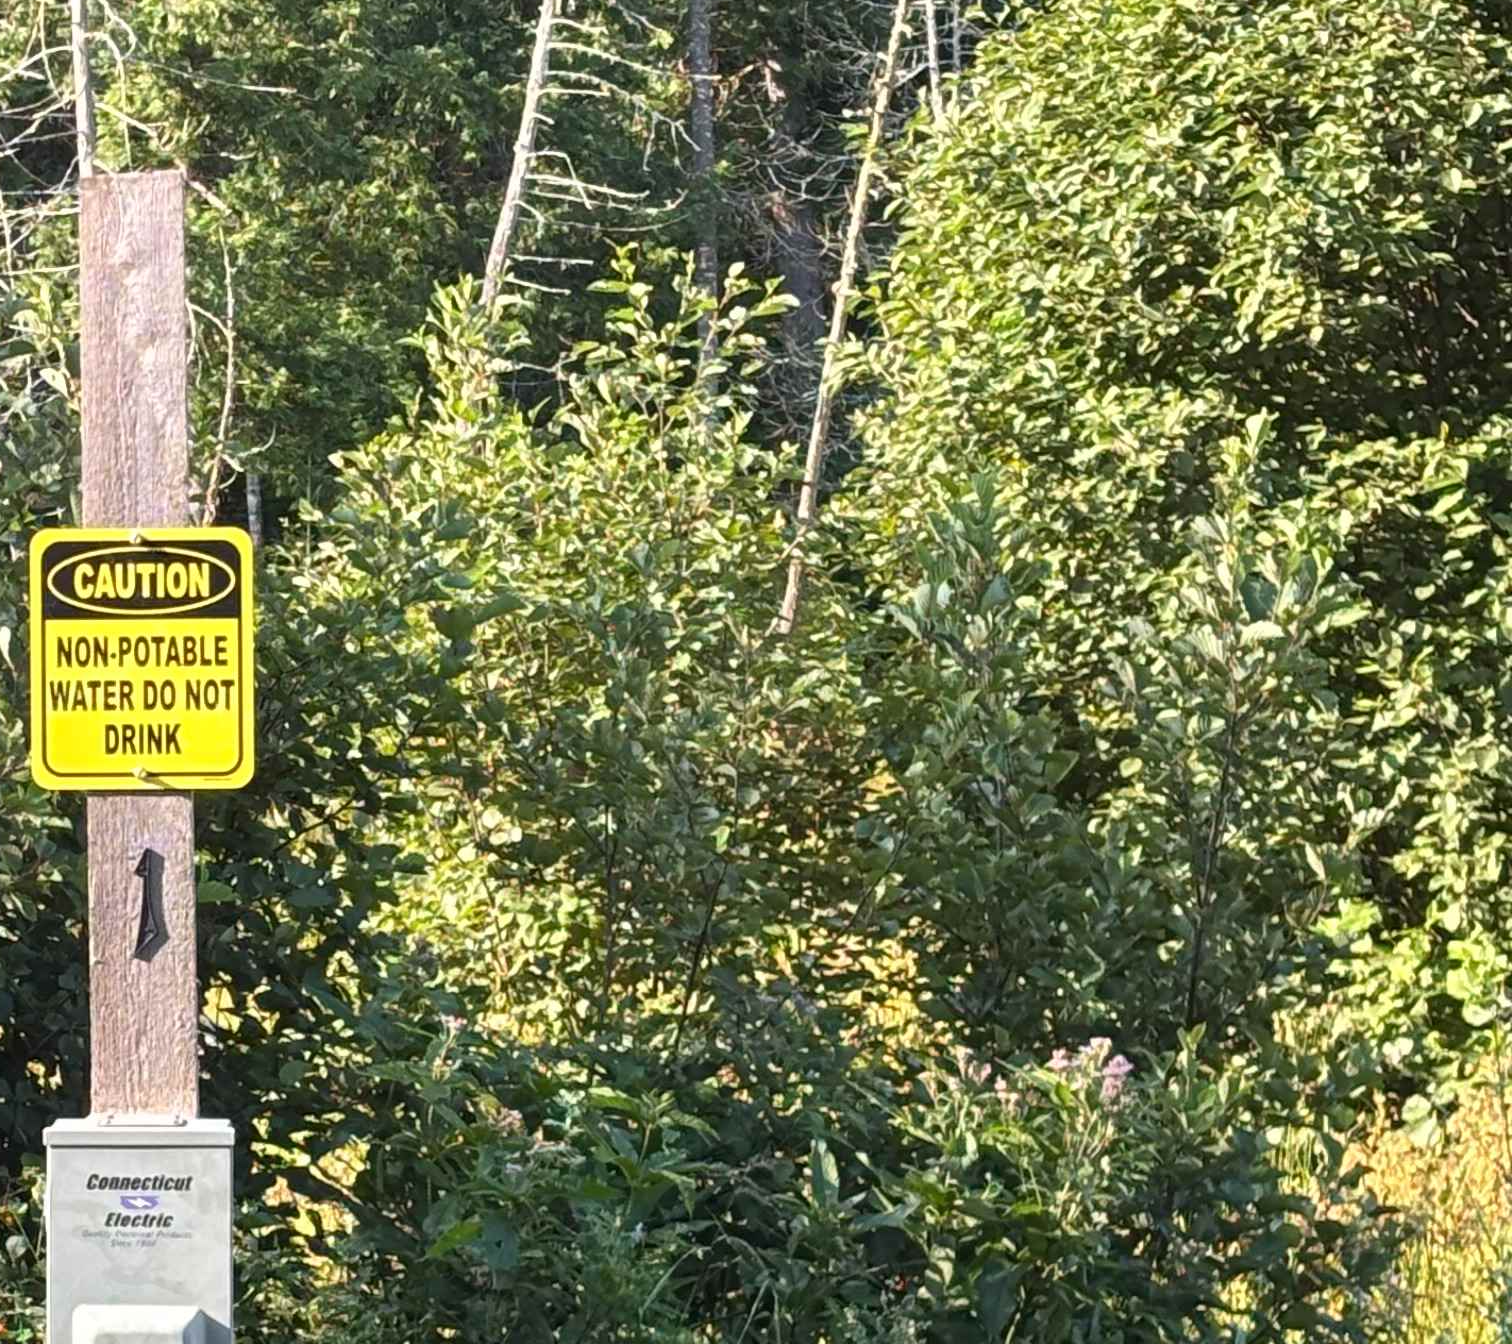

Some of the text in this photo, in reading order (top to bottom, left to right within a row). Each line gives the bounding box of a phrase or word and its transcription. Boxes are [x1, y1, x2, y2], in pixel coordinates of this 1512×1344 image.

[73, 562, 210, 599] CAUTION
[56, 635, 228, 667] NON-POTABLE
[50, 679, 235, 711] WATER DO NOT
[104, 723, 182, 754] DRINK
[87, 1174, 193, 1191] Connecticut
[104, 1212, 174, 1228] Electric
